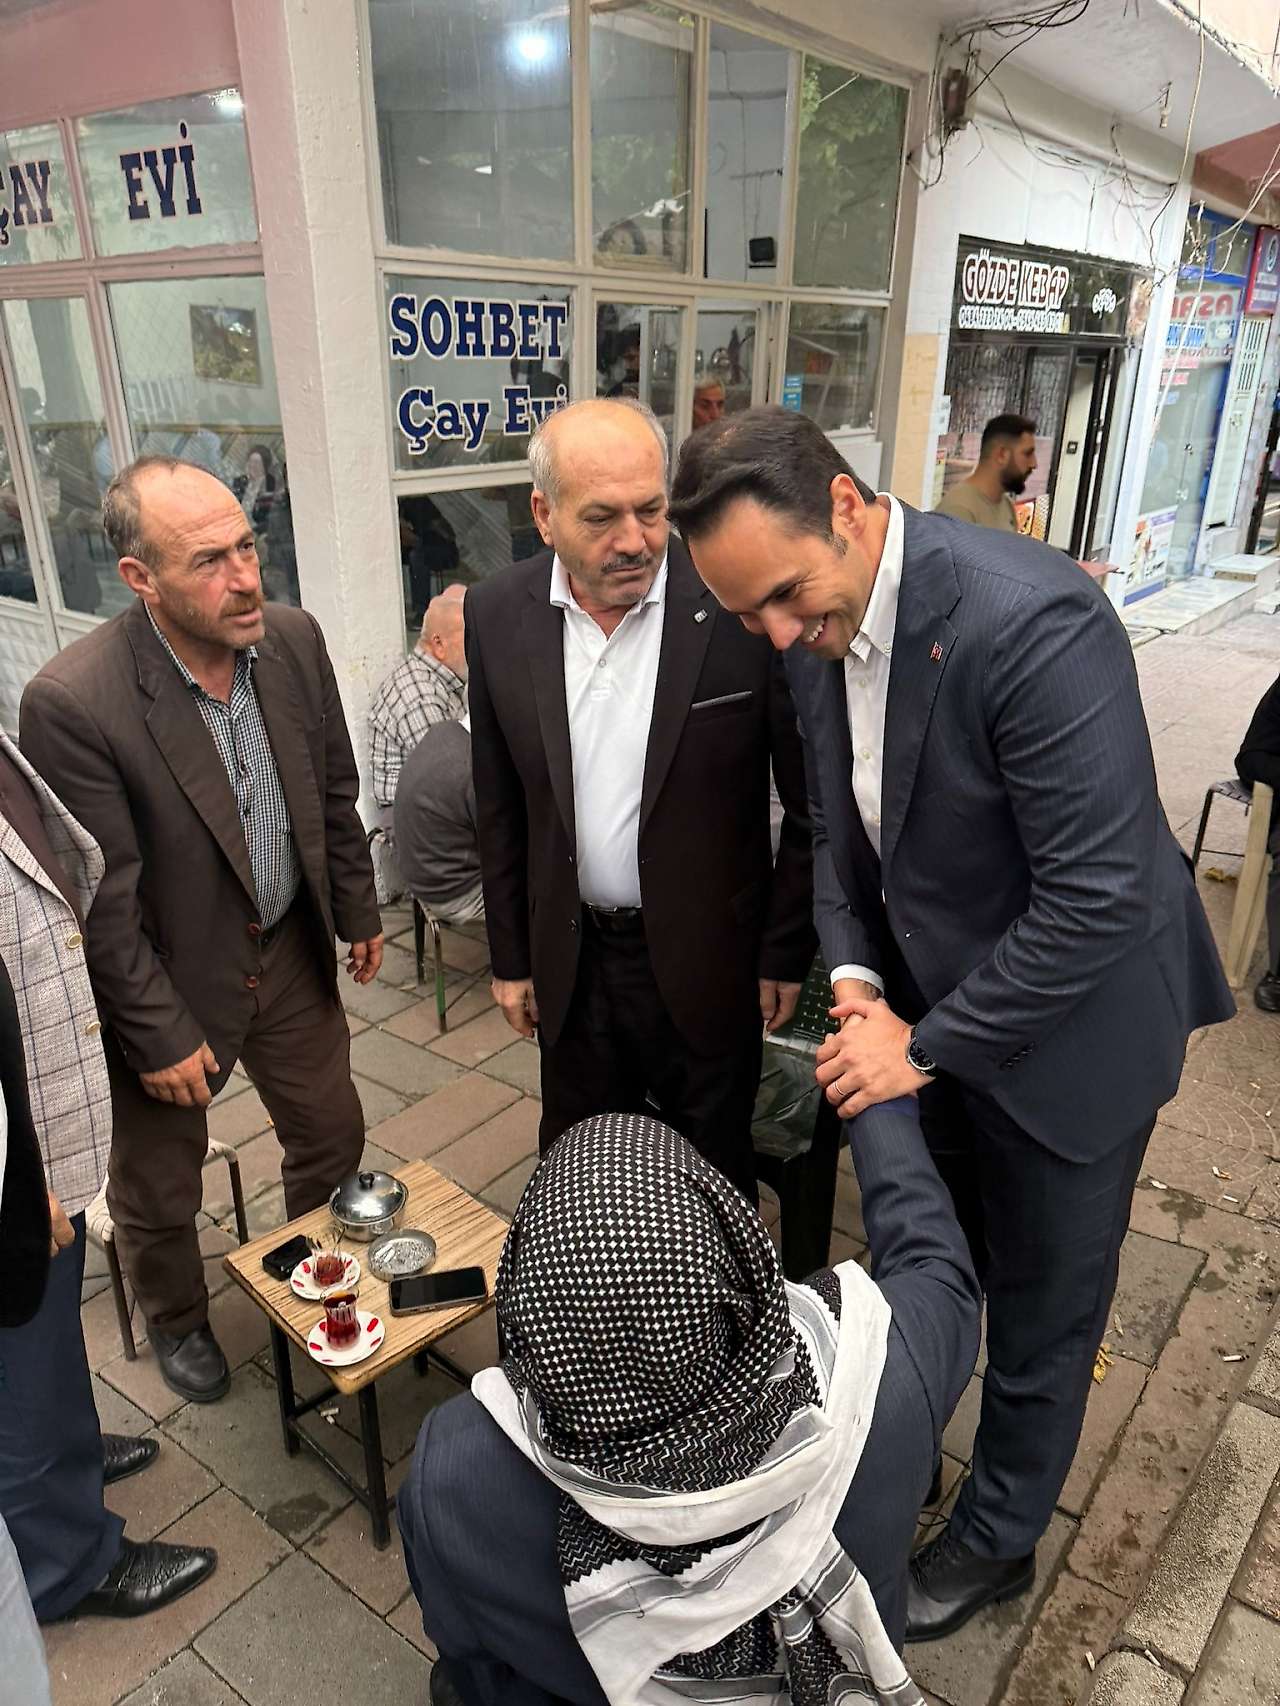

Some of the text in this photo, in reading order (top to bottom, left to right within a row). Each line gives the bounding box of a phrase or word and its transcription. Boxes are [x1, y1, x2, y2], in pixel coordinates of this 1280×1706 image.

[119, 119, 202, 220] EVİ
[962, 248, 1021, 305] GÖZDE
[1018, 260, 1070, 310] KEBAP
[390, 293, 568, 359] SOHBET
[397, 387, 490, 454] Çay
